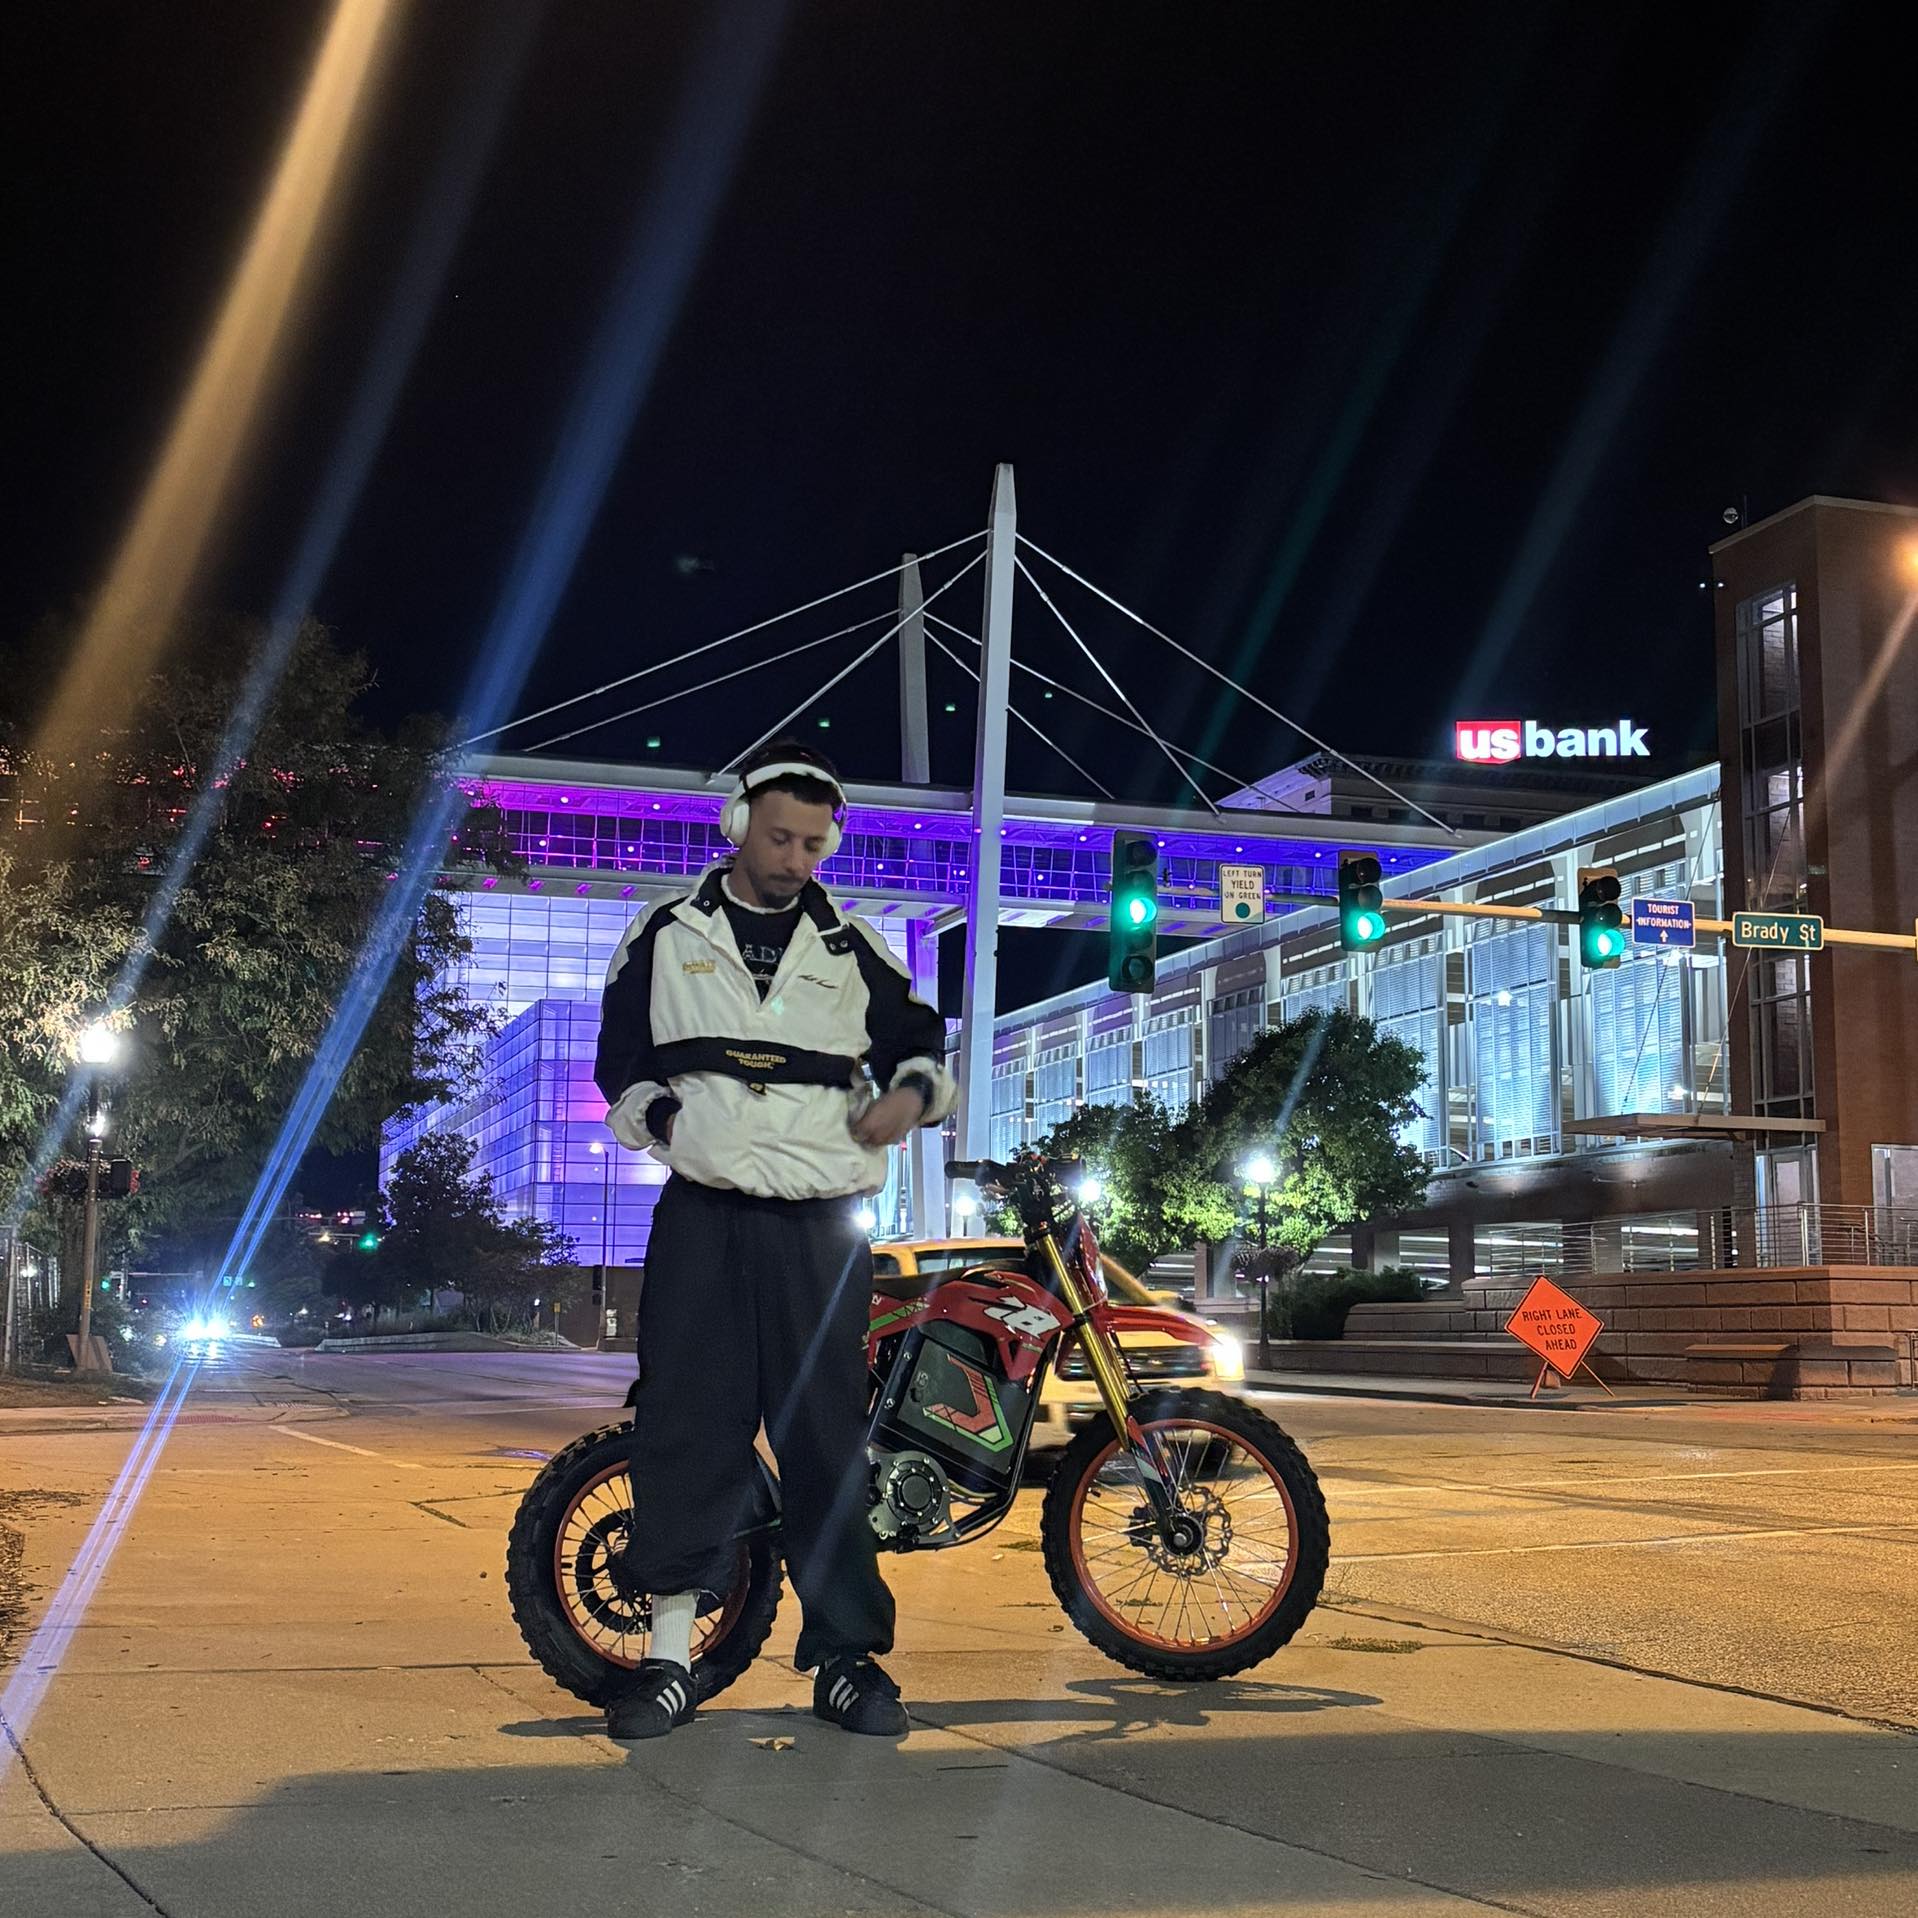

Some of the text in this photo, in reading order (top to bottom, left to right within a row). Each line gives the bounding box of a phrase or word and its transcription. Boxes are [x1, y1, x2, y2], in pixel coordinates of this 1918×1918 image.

[1243, 870, 1262, 878] TURN
[1231, 880, 1254, 890] YIELD
[1239, 892, 1261, 900] GREEN
[1647, 903, 1679, 915] TOURIST
[1741, 920, 1816, 944] Brady St
[725, 1049, 787, 1064] GUARANTEED
[1521, 1308, 1583, 1322] RIGHT LANE
[1536, 1323, 1576, 1336] CLOSED
[1545, 1338, 1577, 1351] AHEAD
